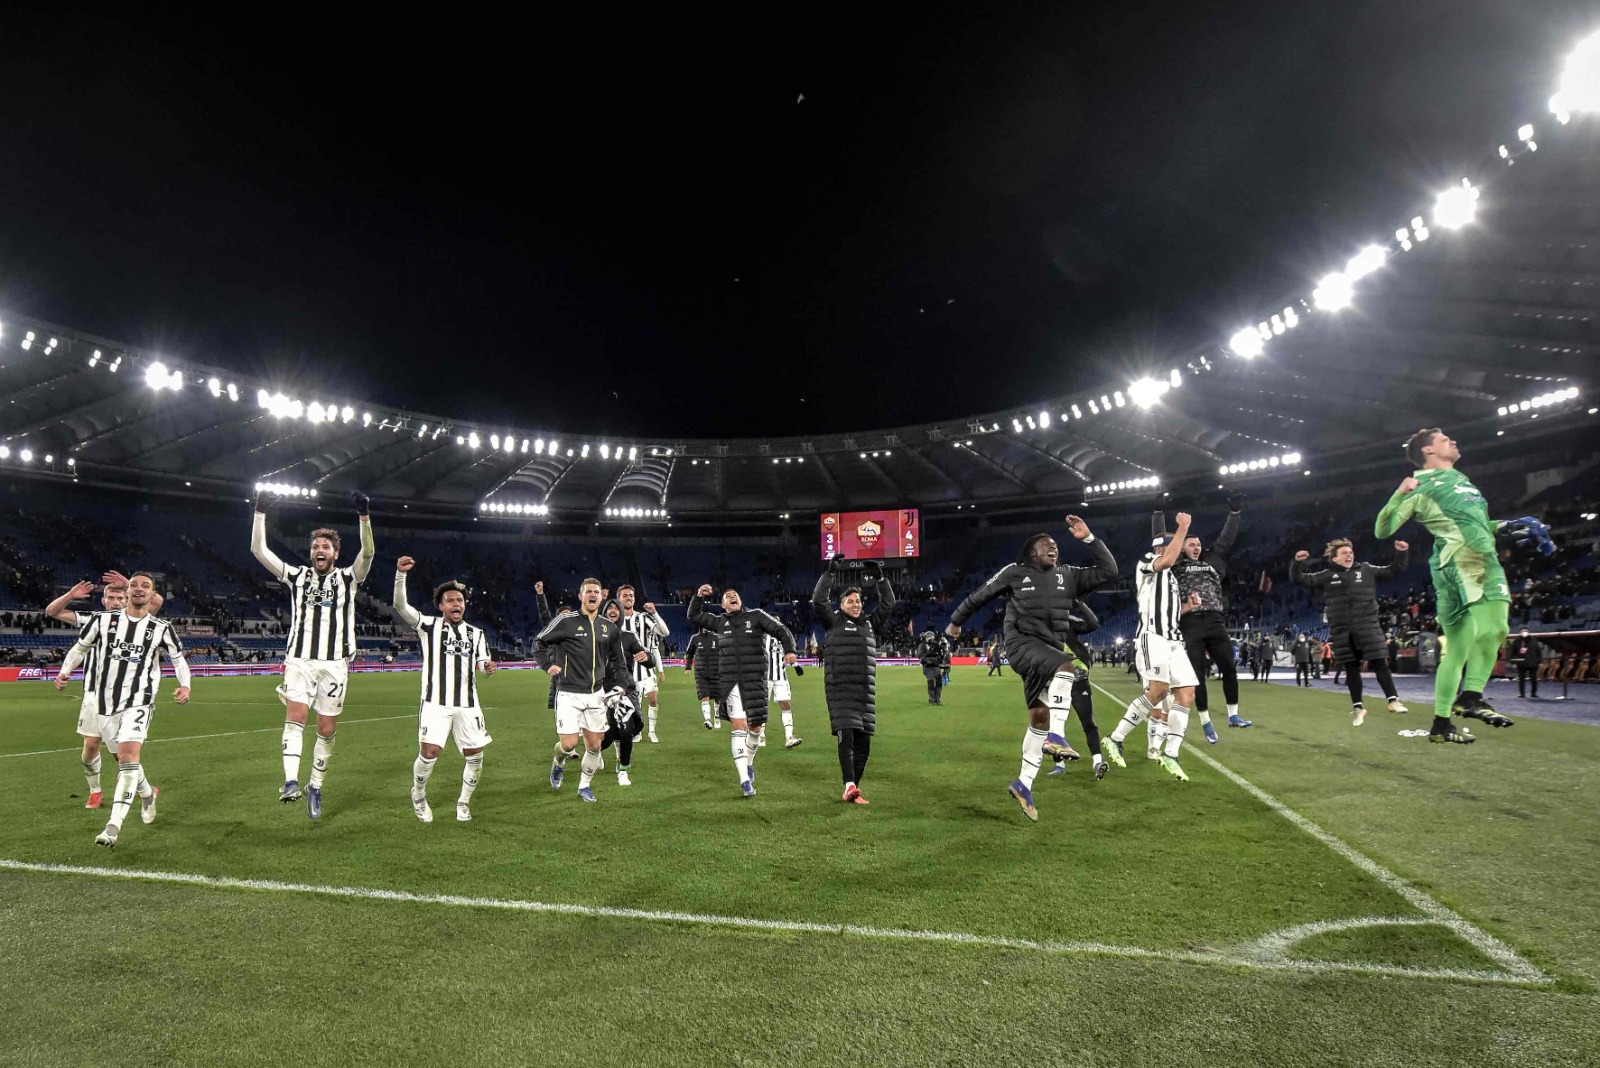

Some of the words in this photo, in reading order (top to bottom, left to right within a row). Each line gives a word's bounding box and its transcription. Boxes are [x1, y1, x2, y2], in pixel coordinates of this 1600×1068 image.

[826, 533, 834, 544] 3
[905, 530, 914, 540] 4
[849, 560, 885, 568] OLIO
[1185, 565, 1210, 573] Allianz
[305, 586, 334, 599] Jeep
[110, 638, 144, 654] Jeep
[443, 637, 472, 650] Jeep
[134, 709, 146, 725] 2
